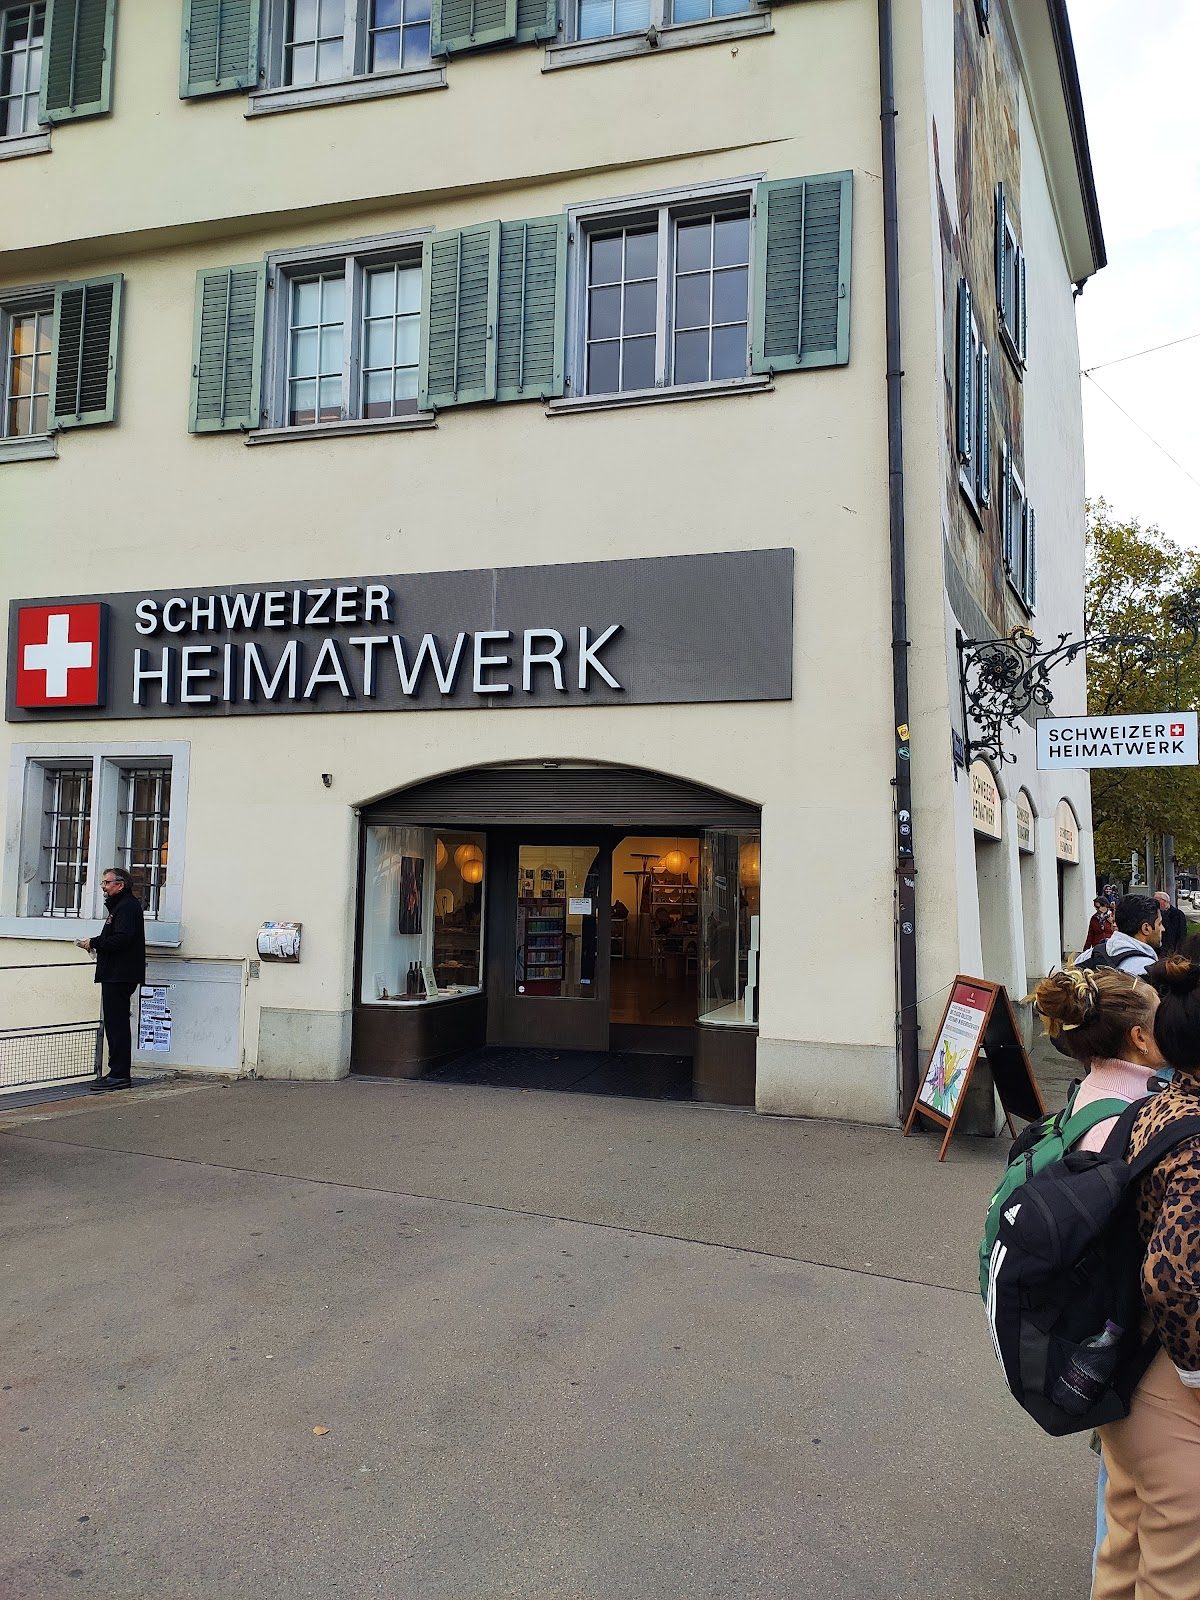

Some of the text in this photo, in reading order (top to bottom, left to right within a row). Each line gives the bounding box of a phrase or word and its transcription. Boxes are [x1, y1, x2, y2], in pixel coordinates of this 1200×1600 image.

[135, 584, 392, 635] SCHWEIZER
[132, 624, 623, 704] HEIMATWERK
[1049, 724, 1166, 742] SCHWEIZER
[1049, 740, 1185, 758] HEIMATWERK
